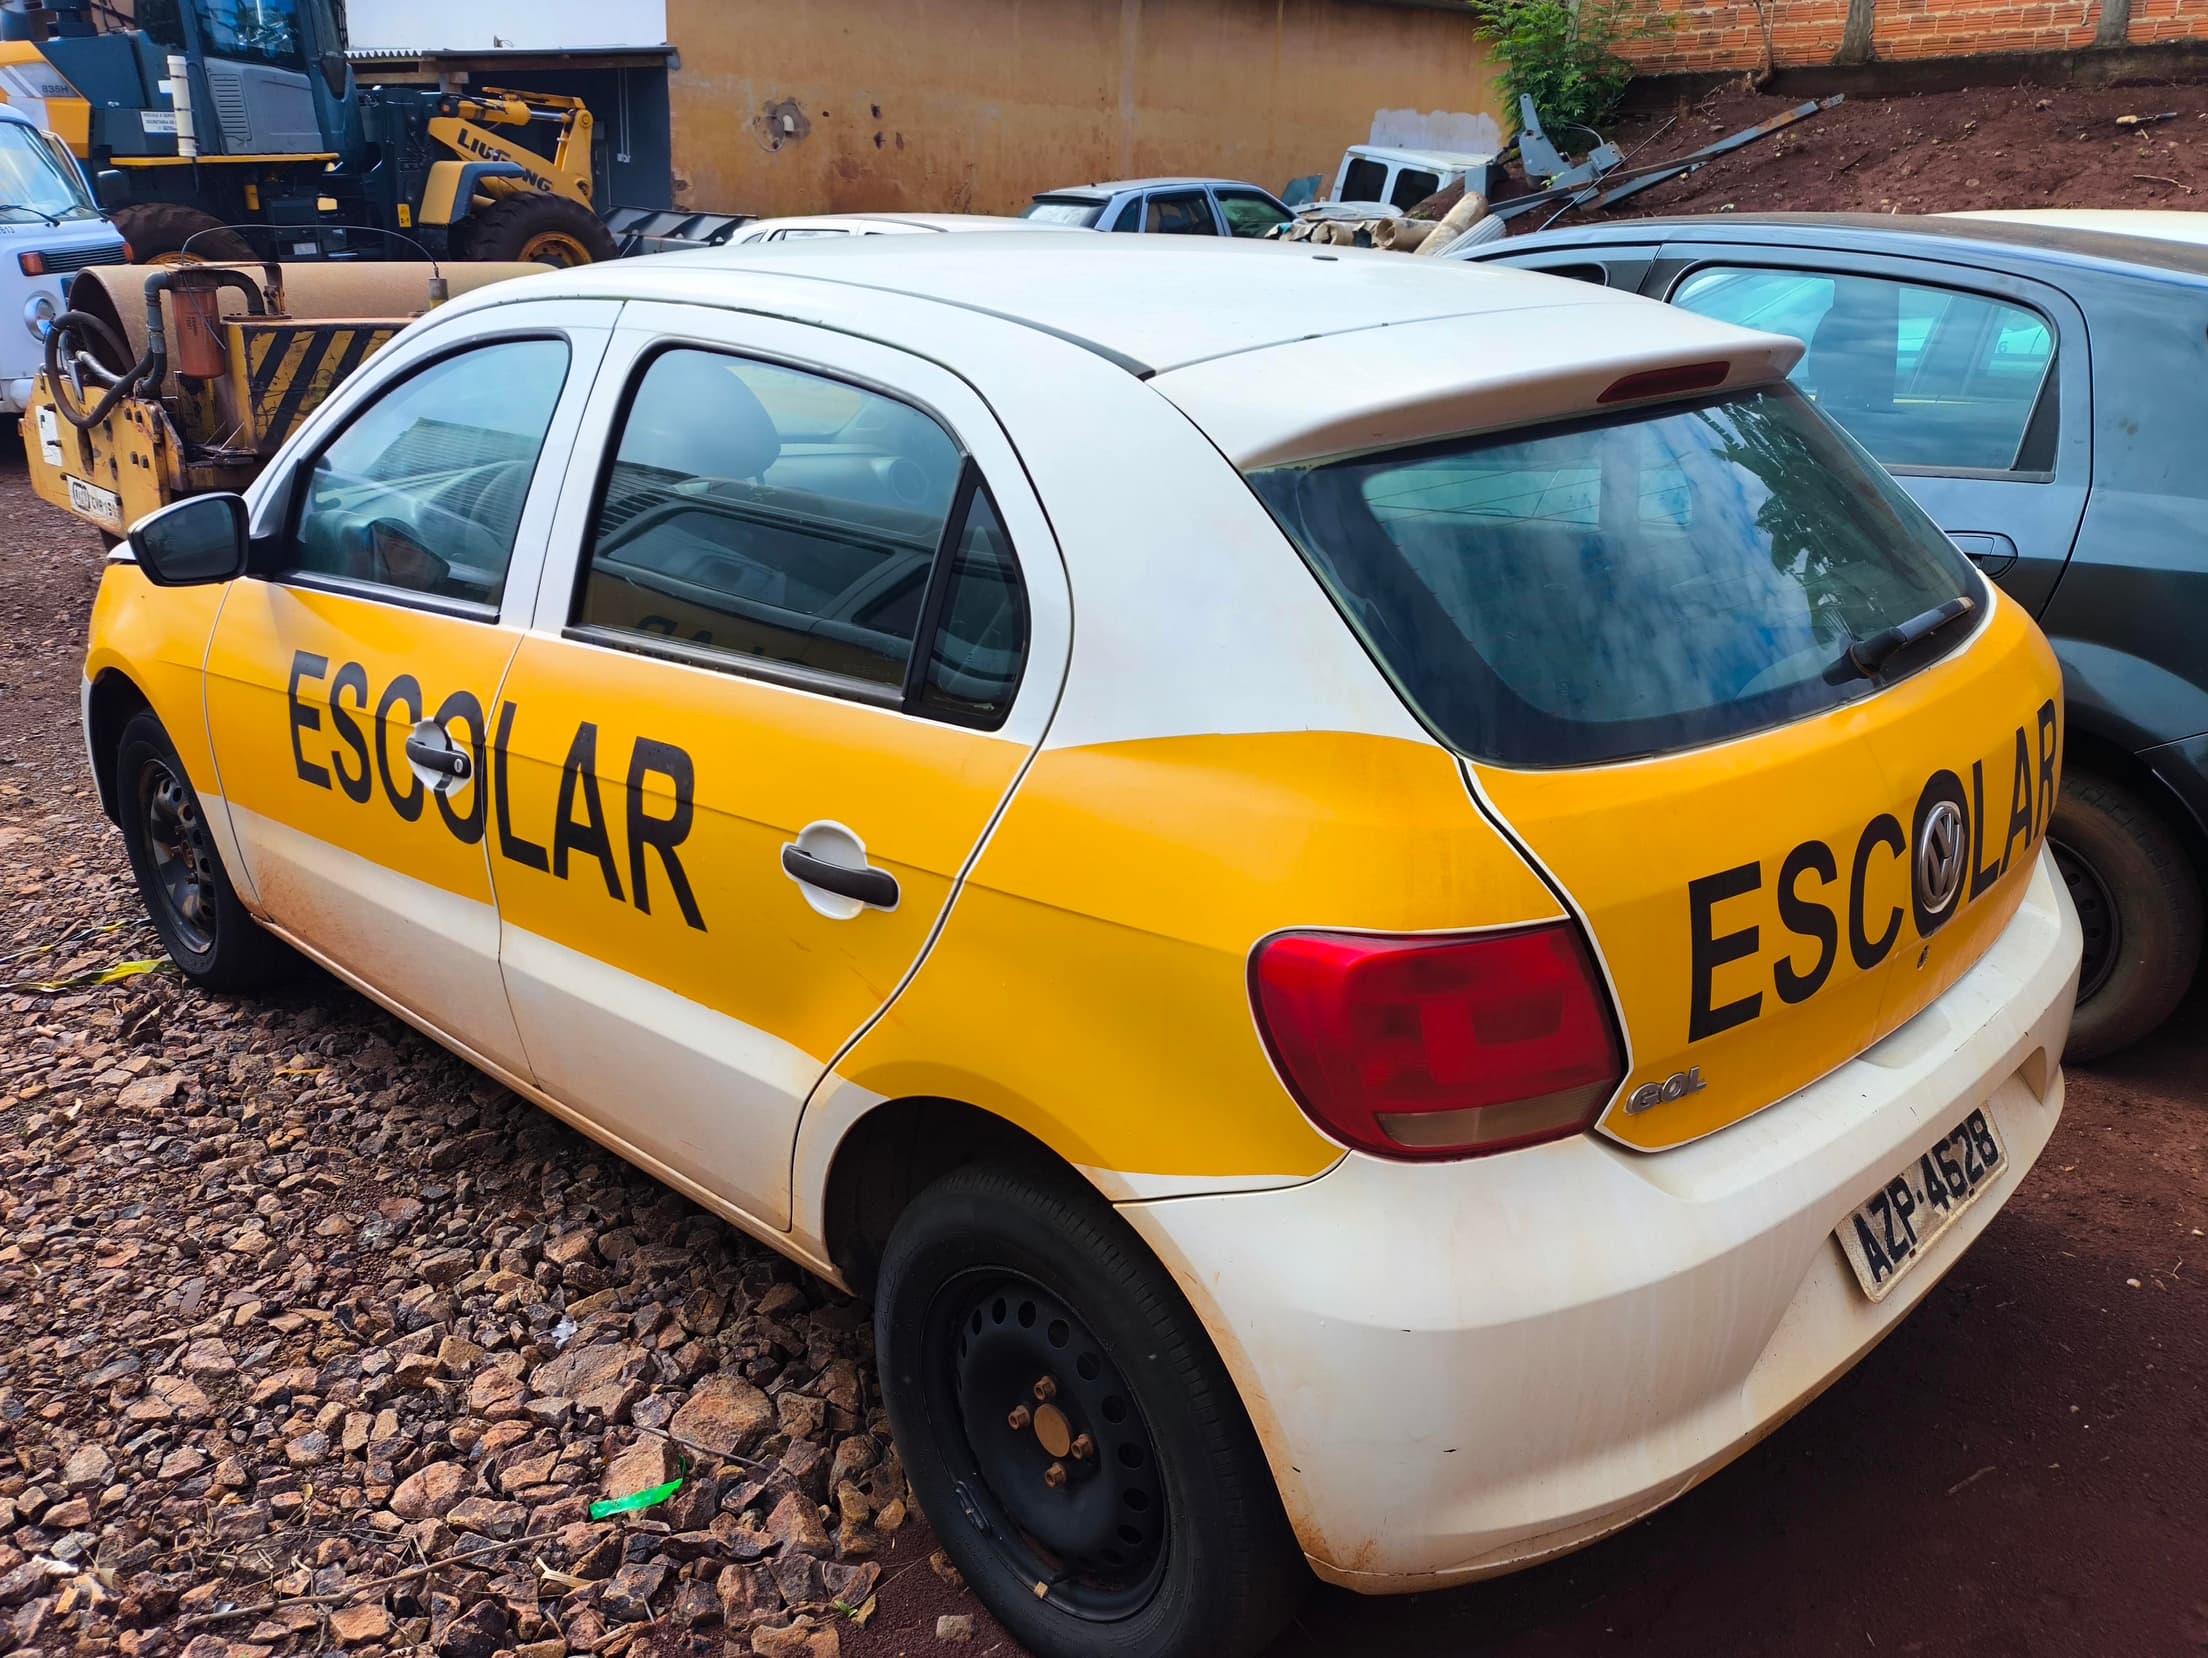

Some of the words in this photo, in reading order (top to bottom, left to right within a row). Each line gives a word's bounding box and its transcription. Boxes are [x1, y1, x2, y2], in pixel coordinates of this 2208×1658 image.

[457, 128, 553, 192] LIUGNG
[288, 649, 709, 933] ESCOLAR
[1687, 698, 2058, 1044] ESCOLAR
[1623, 1065, 1708, 1116] GOL
